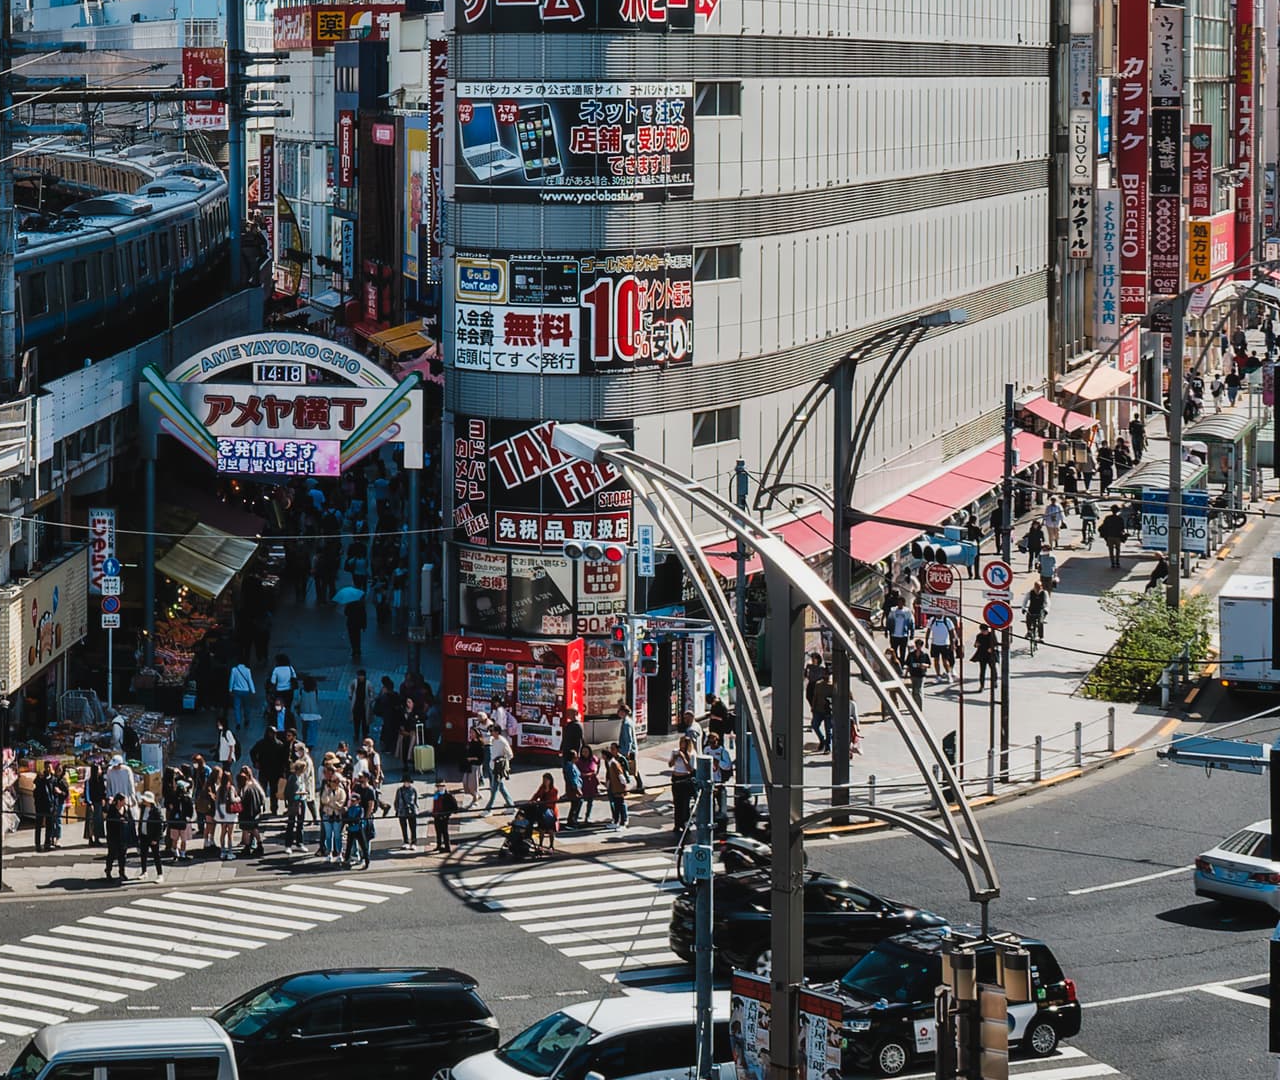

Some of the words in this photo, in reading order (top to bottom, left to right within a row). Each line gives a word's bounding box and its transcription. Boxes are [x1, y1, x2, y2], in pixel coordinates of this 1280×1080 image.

[320, 13, 344, 38] 薬
[463, 83, 623, 97] ヨドバシカメラの公式通販サイト
[579, 98, 686, 124] ネットで注文
[1121, 56, 1145, 152] カラオケ
[569, 124, 690, 154] 店舗で受け取り
[1121, 173, 1140, 207] BIG
[1071, 197, 1089, 250] ルノアール
[1121, 211, 1139, 258] ECHO
[1192, 224, 1209, 282] 処方せん
[456, 308, 495, 328] 入会金
[503, 311, 573, 349] 無料
[200, 339, 361, 375] AMEYAYOKOCHO
[456, 348, 576, 370] 店頭にてすぐ発行
[260, 364, 301, 382] 14:18
[203, 395, 367, 431] アメヤ横丁
[218, 440, 316, 459] を発信します
[468, 419, 486, 501] ヨドバシ
[455, 437, 469, 500] カメラ
[599, 489, 632, 508] STORE
[499, 517, 629, 542] 免税品取扱店
[1143, 515, 1157, 525] MI
[1181, 517, 1196, 528] MI
[546, 603, 571, 617] VISA
